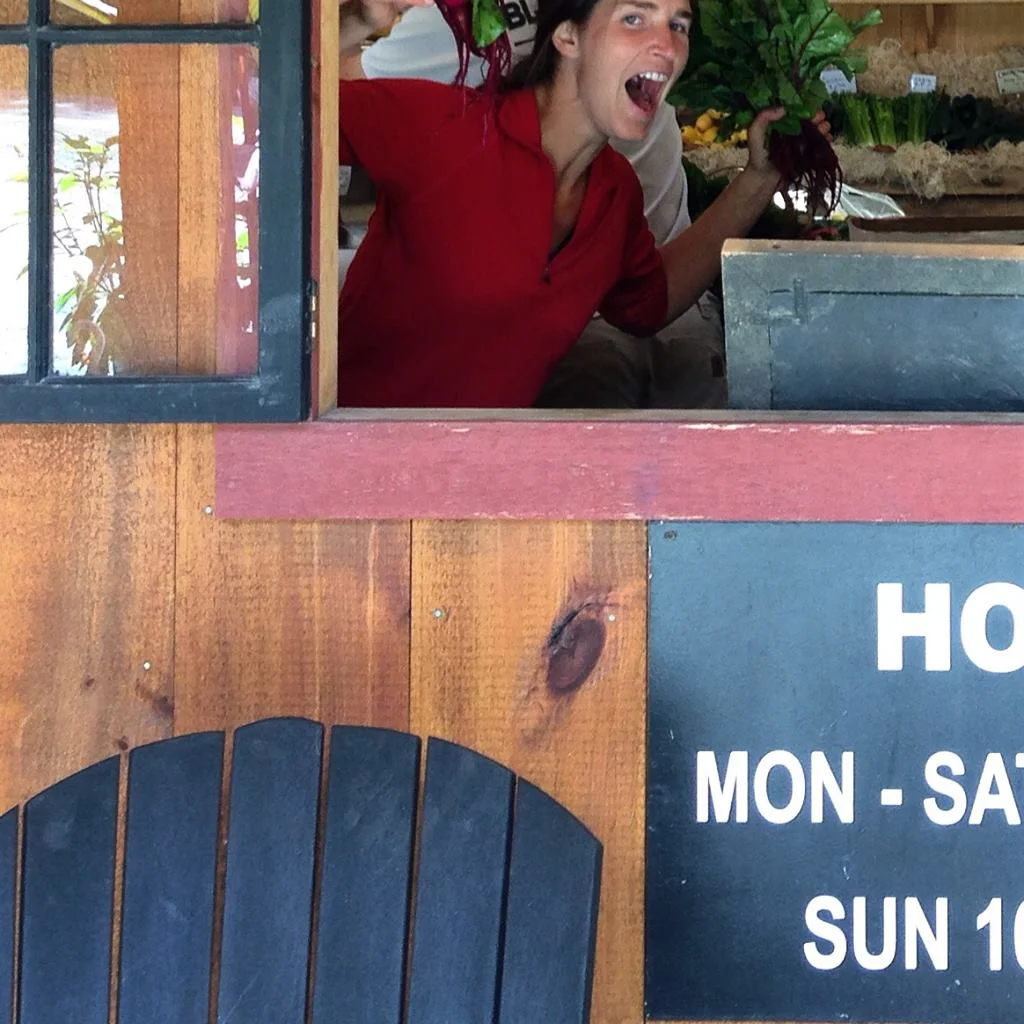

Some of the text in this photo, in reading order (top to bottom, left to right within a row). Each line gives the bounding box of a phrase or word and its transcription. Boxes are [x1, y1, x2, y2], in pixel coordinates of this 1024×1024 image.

[695, 749, 855, 825] MON
[880, 788, 903, 806] -
[802, 894, 949, 971] SUN
